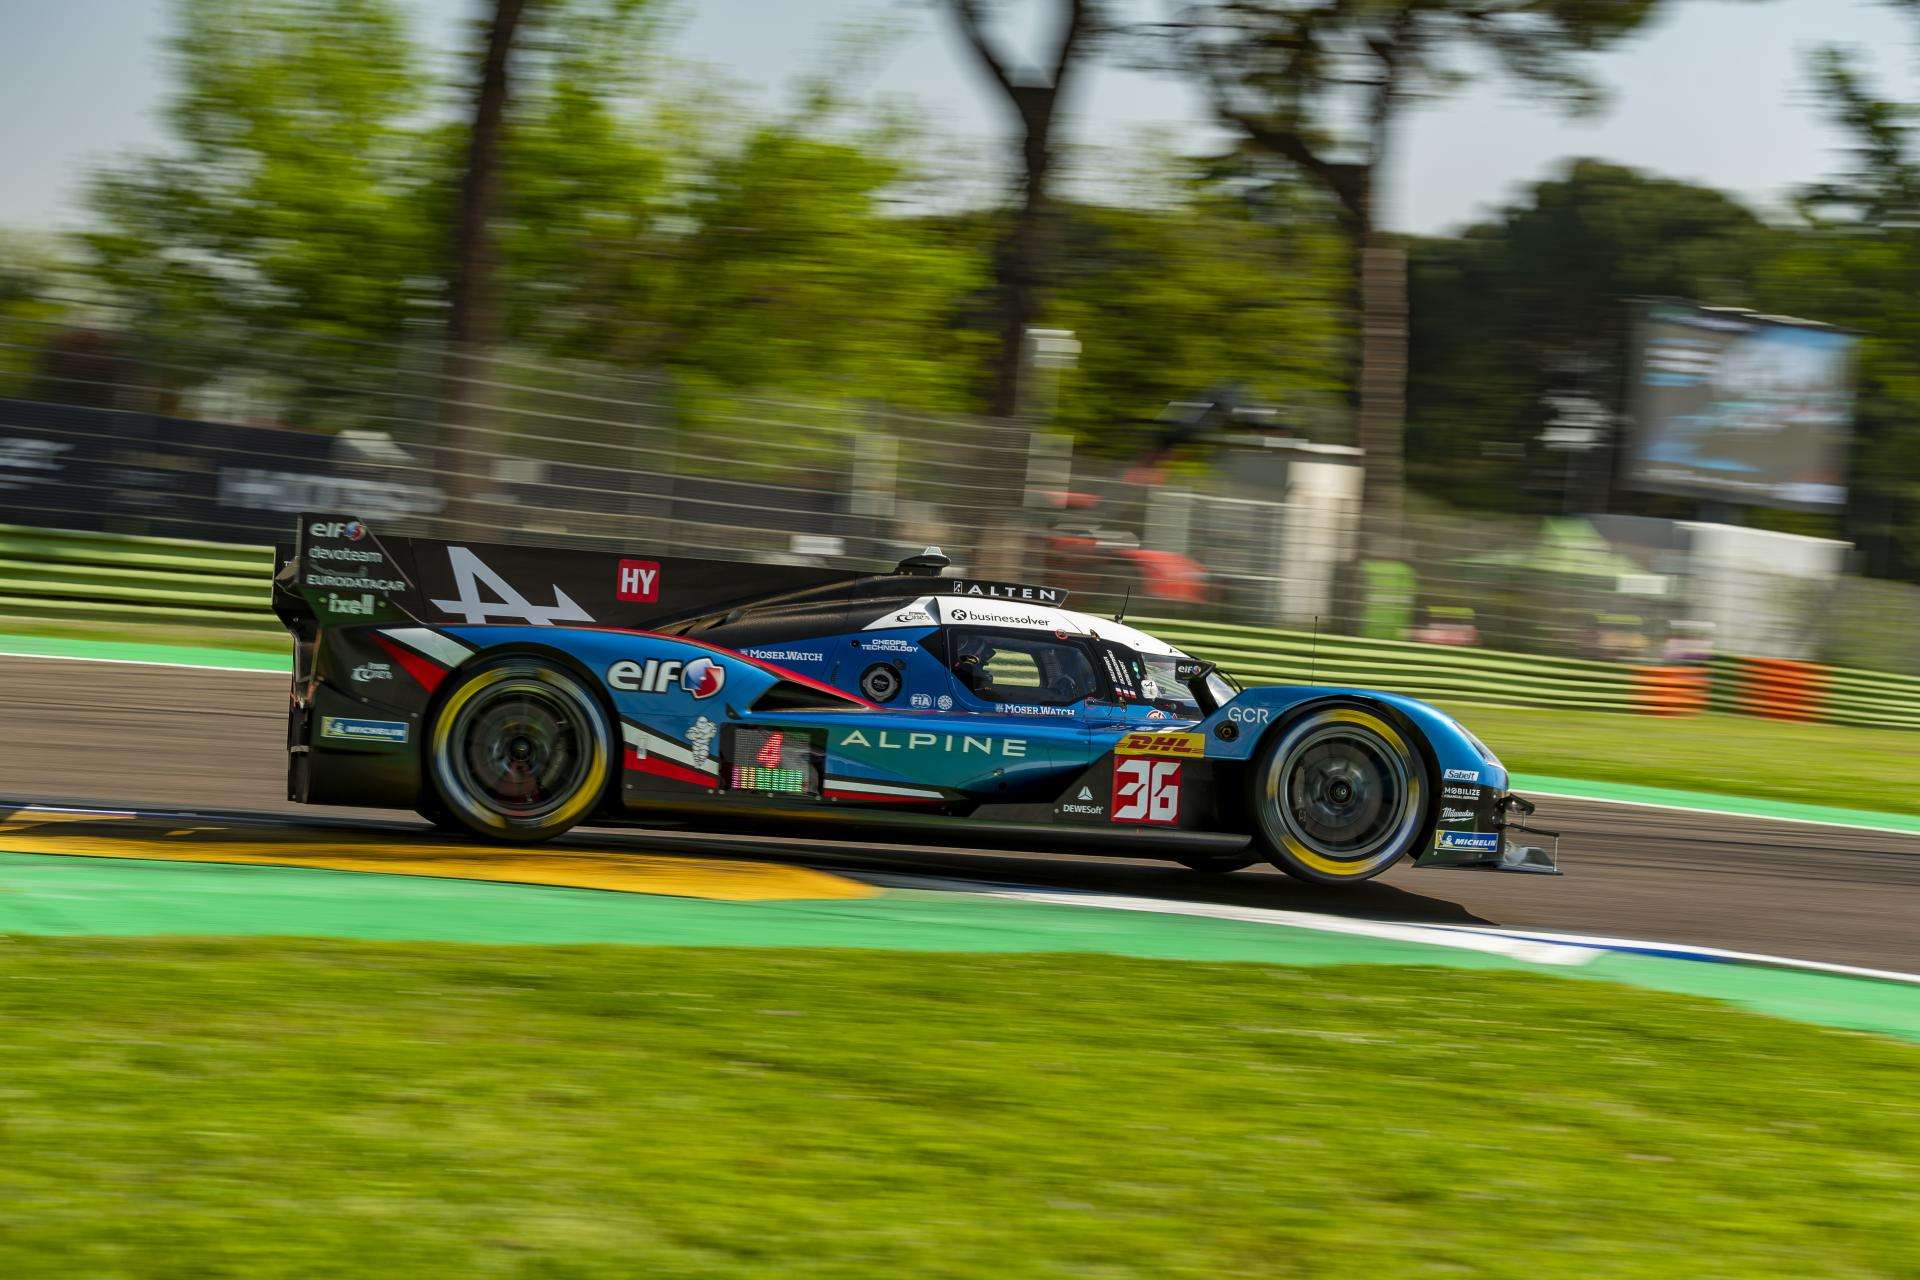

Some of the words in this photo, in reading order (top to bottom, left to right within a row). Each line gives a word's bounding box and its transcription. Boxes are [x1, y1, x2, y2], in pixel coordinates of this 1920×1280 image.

[309, 522, 346, 538] elf
[308, 546, 383, 563] devoteam
[306, 574, 406, 592] EURODATACAR
[621, 567, 656, 595] HY
[967, 584, 1056, 601] ALTEN
[328, 592, 375, 615] ixell
[969, 610, 1051, 627] businessolver
[861, 644, 919, 653] TECHNOLOGY
[607, 659, 682, 693] elf
[1177, 664, 1194, 674] elf
[911, 696, 930, 706] FIA
[1227, 706, 1270, 724] GCR
[756, 730, 784, 769] 4
[840, 729, 1027, 757] ALPINE
[1127, 734, 1191, 754] DHL
[1448, 770, 1475, 780] Sabelt
[1113, 759, 1181, 822] 36
[1454, 838, 1497, 847] MICHELIN
